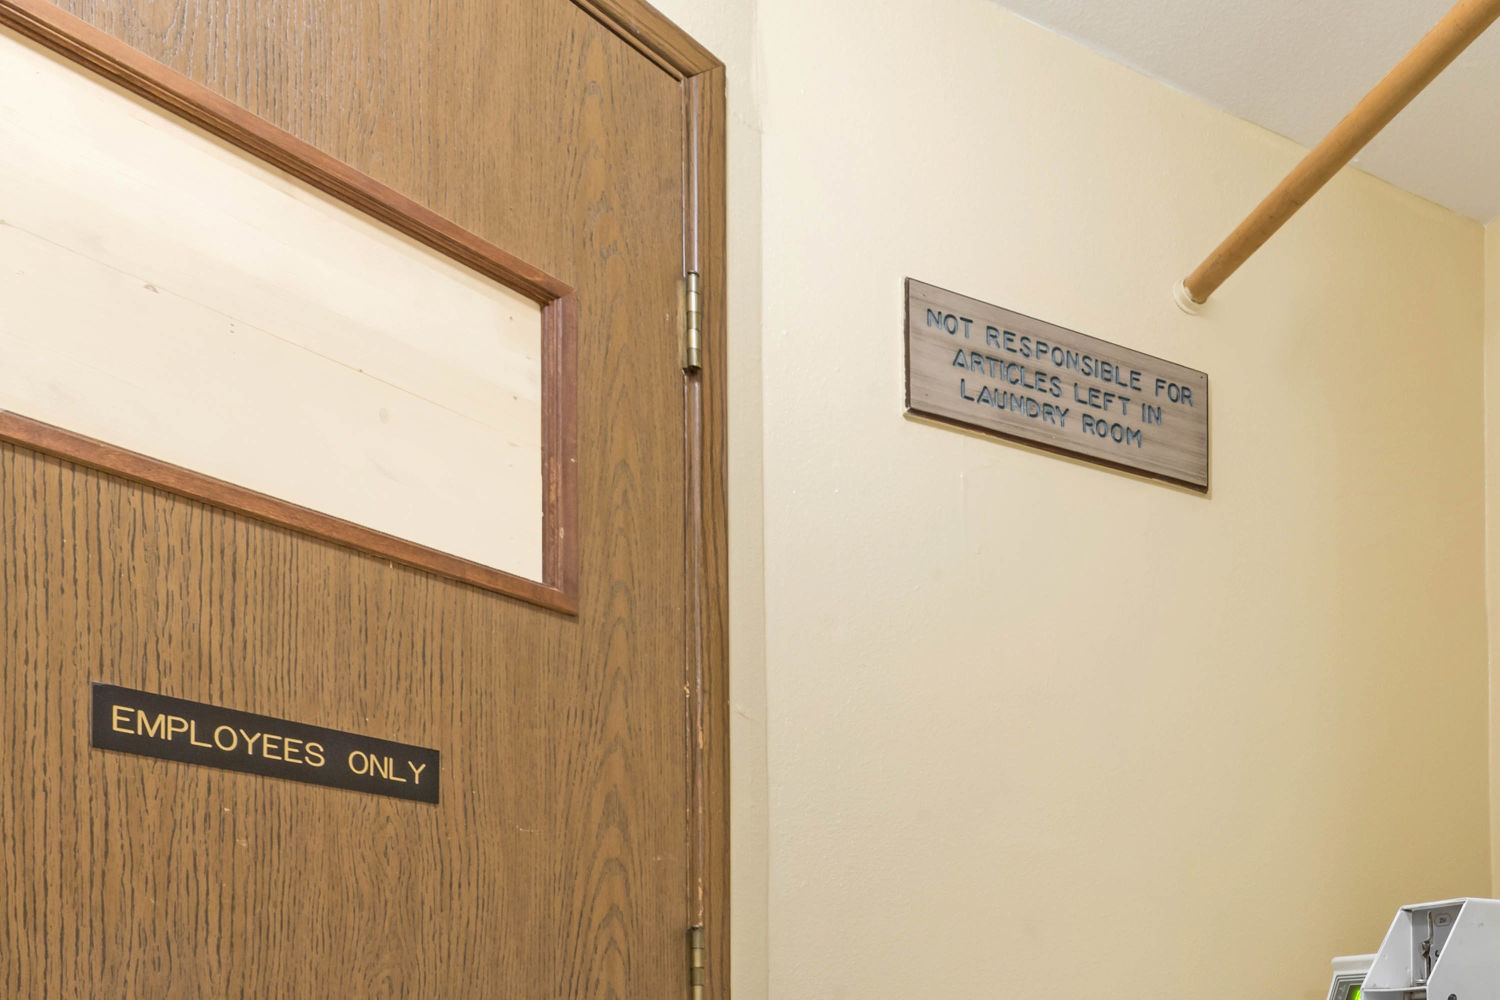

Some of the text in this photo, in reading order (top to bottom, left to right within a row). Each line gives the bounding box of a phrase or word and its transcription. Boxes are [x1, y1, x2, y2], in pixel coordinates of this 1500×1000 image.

[926, 308, 1193, 407] NOT RESPONSIBLE FOR
[952, 348, 1163, 427] ARTICLES LEFT IN
[960, 378, 1143, 448] LAUNDRY ROOM
[112, 704, 426, 784] EMPLOYEES ONLY
